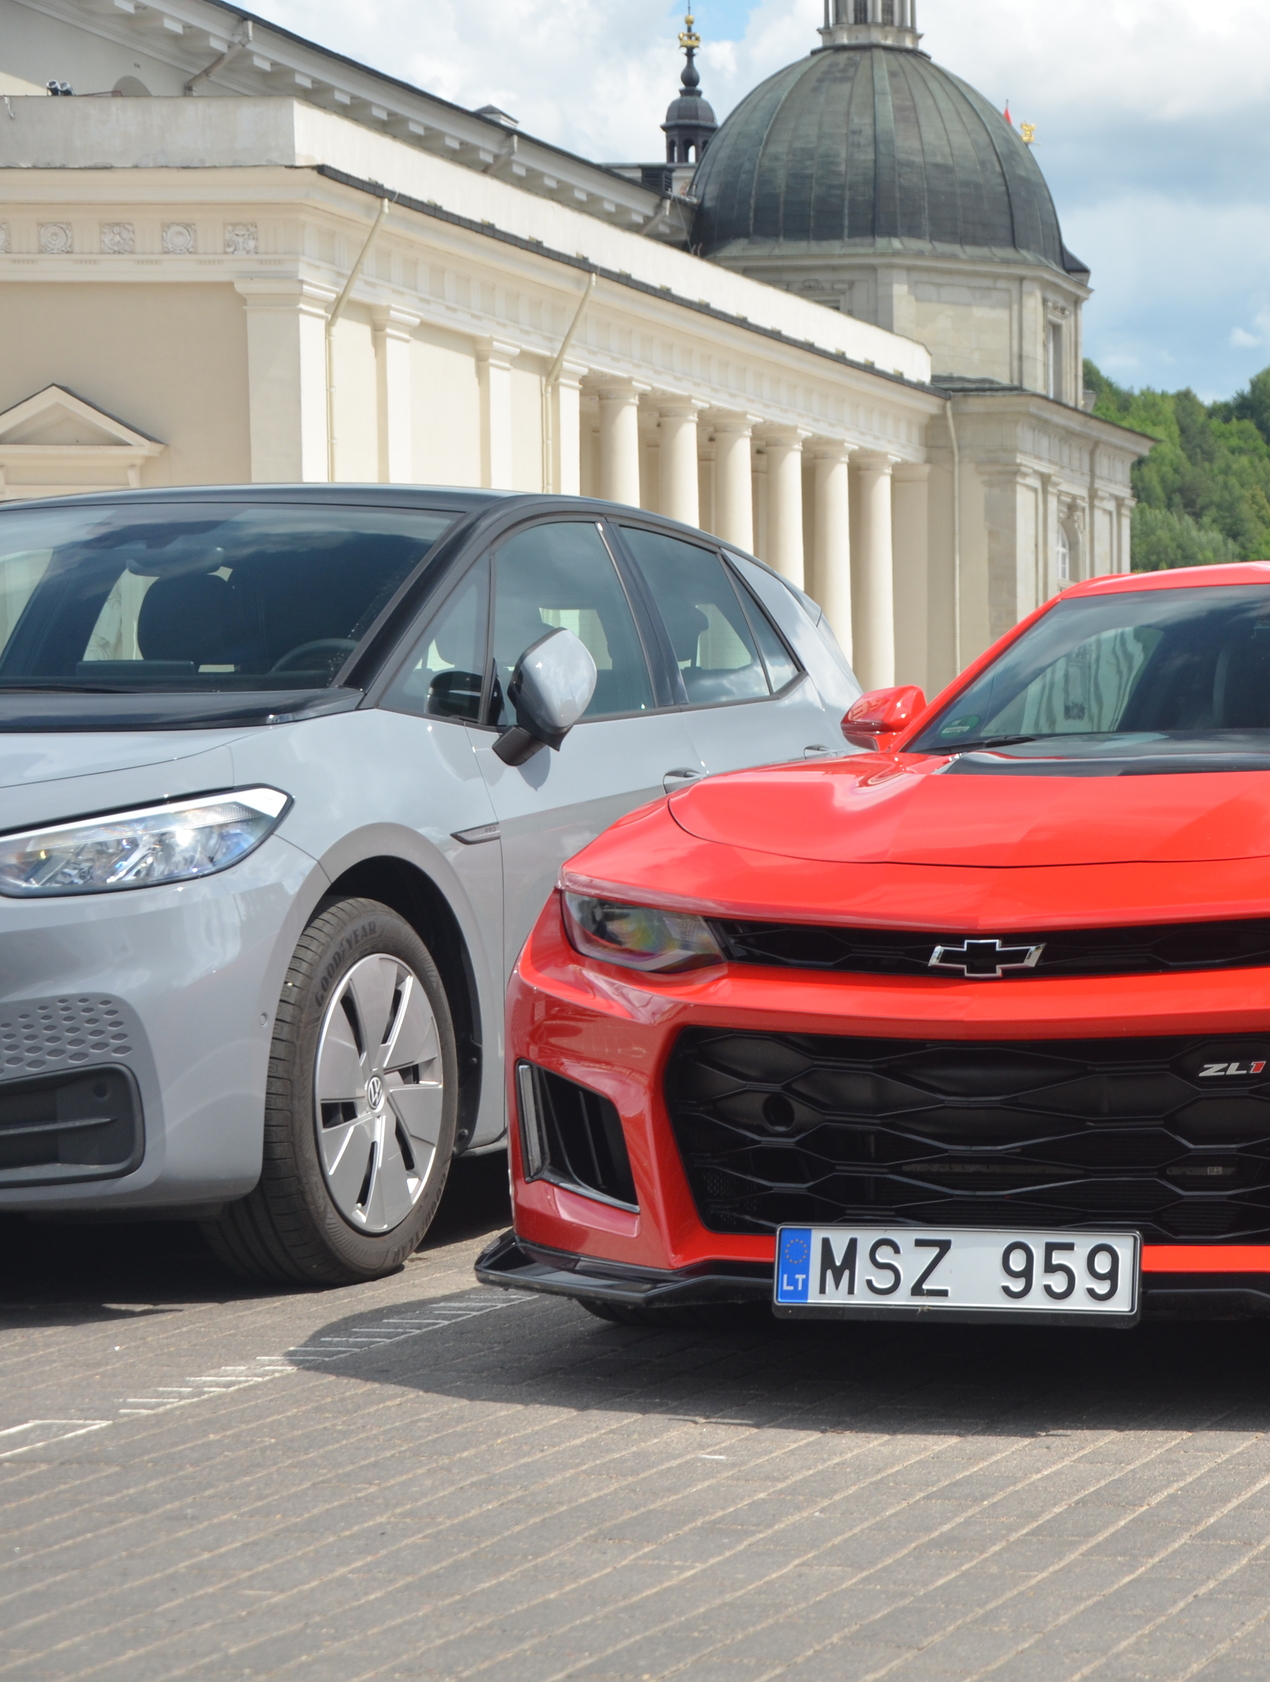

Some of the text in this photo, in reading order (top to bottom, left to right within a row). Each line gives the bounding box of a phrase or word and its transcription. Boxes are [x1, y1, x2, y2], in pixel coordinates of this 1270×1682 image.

[315, 920, 377, 1008] GOODYEAR
[1199, 1061, 1266, 1077] ZL1
[782, 1274, 807, 1292] LT
[818, 1237, 1121, 1302] MSZ 959
